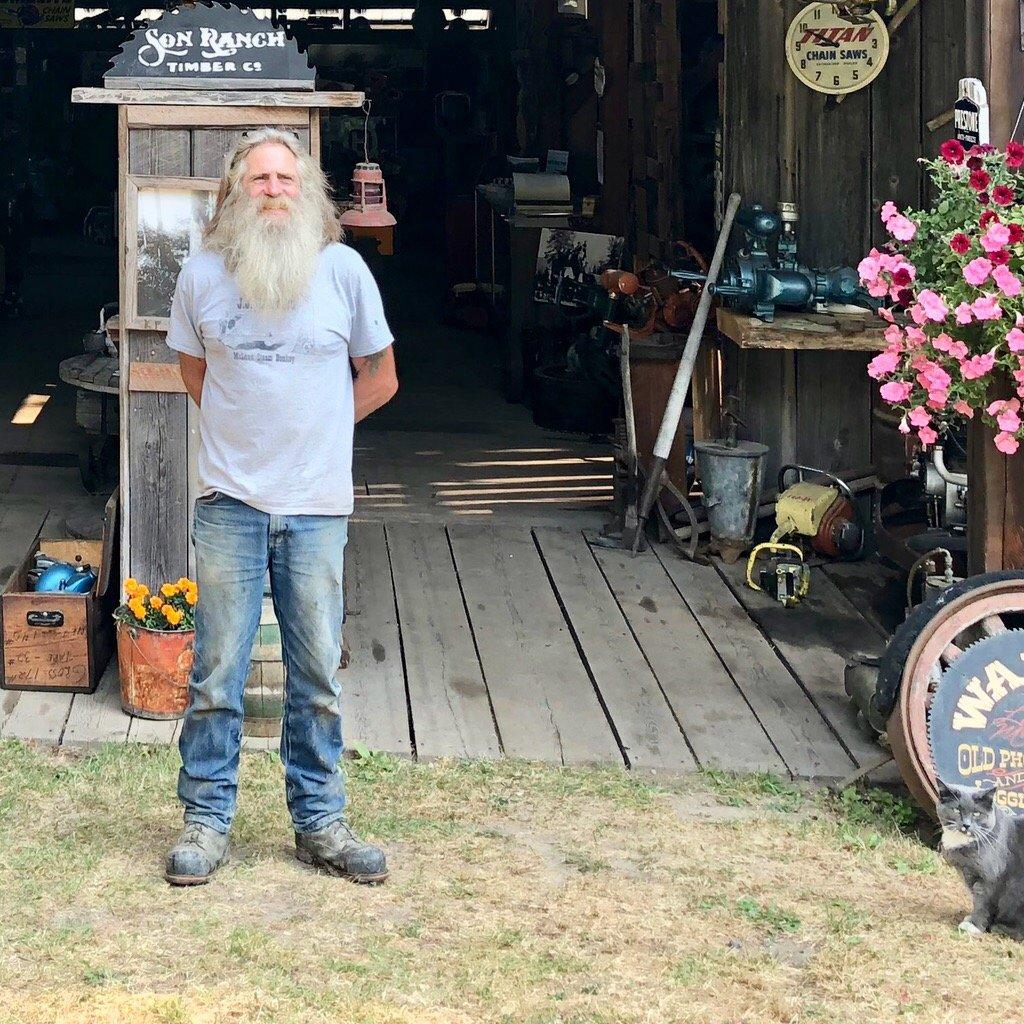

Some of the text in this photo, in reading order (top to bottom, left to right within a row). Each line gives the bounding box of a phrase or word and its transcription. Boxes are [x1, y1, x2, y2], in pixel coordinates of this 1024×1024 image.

[800, 27, 874, 44] TITAN
[199, 27, 286, 58] RANCH
[872, 39, 878, 49] 3
[806, 49, 868, 61] CHAIN SAWS
[167, 62, 237, 72] TIMBER
[800, 59, 806, 69] 8
[866, 57, 873, 67] 4
[816, 71, 822, 81] 7
[852, 70, 859, 80] 5
[833, 76, 839, 86] 6
[952, 652, 1024, 732] WA
[957, 743, 995, 776] OLD
[999, 749, 1024, 769] PH
